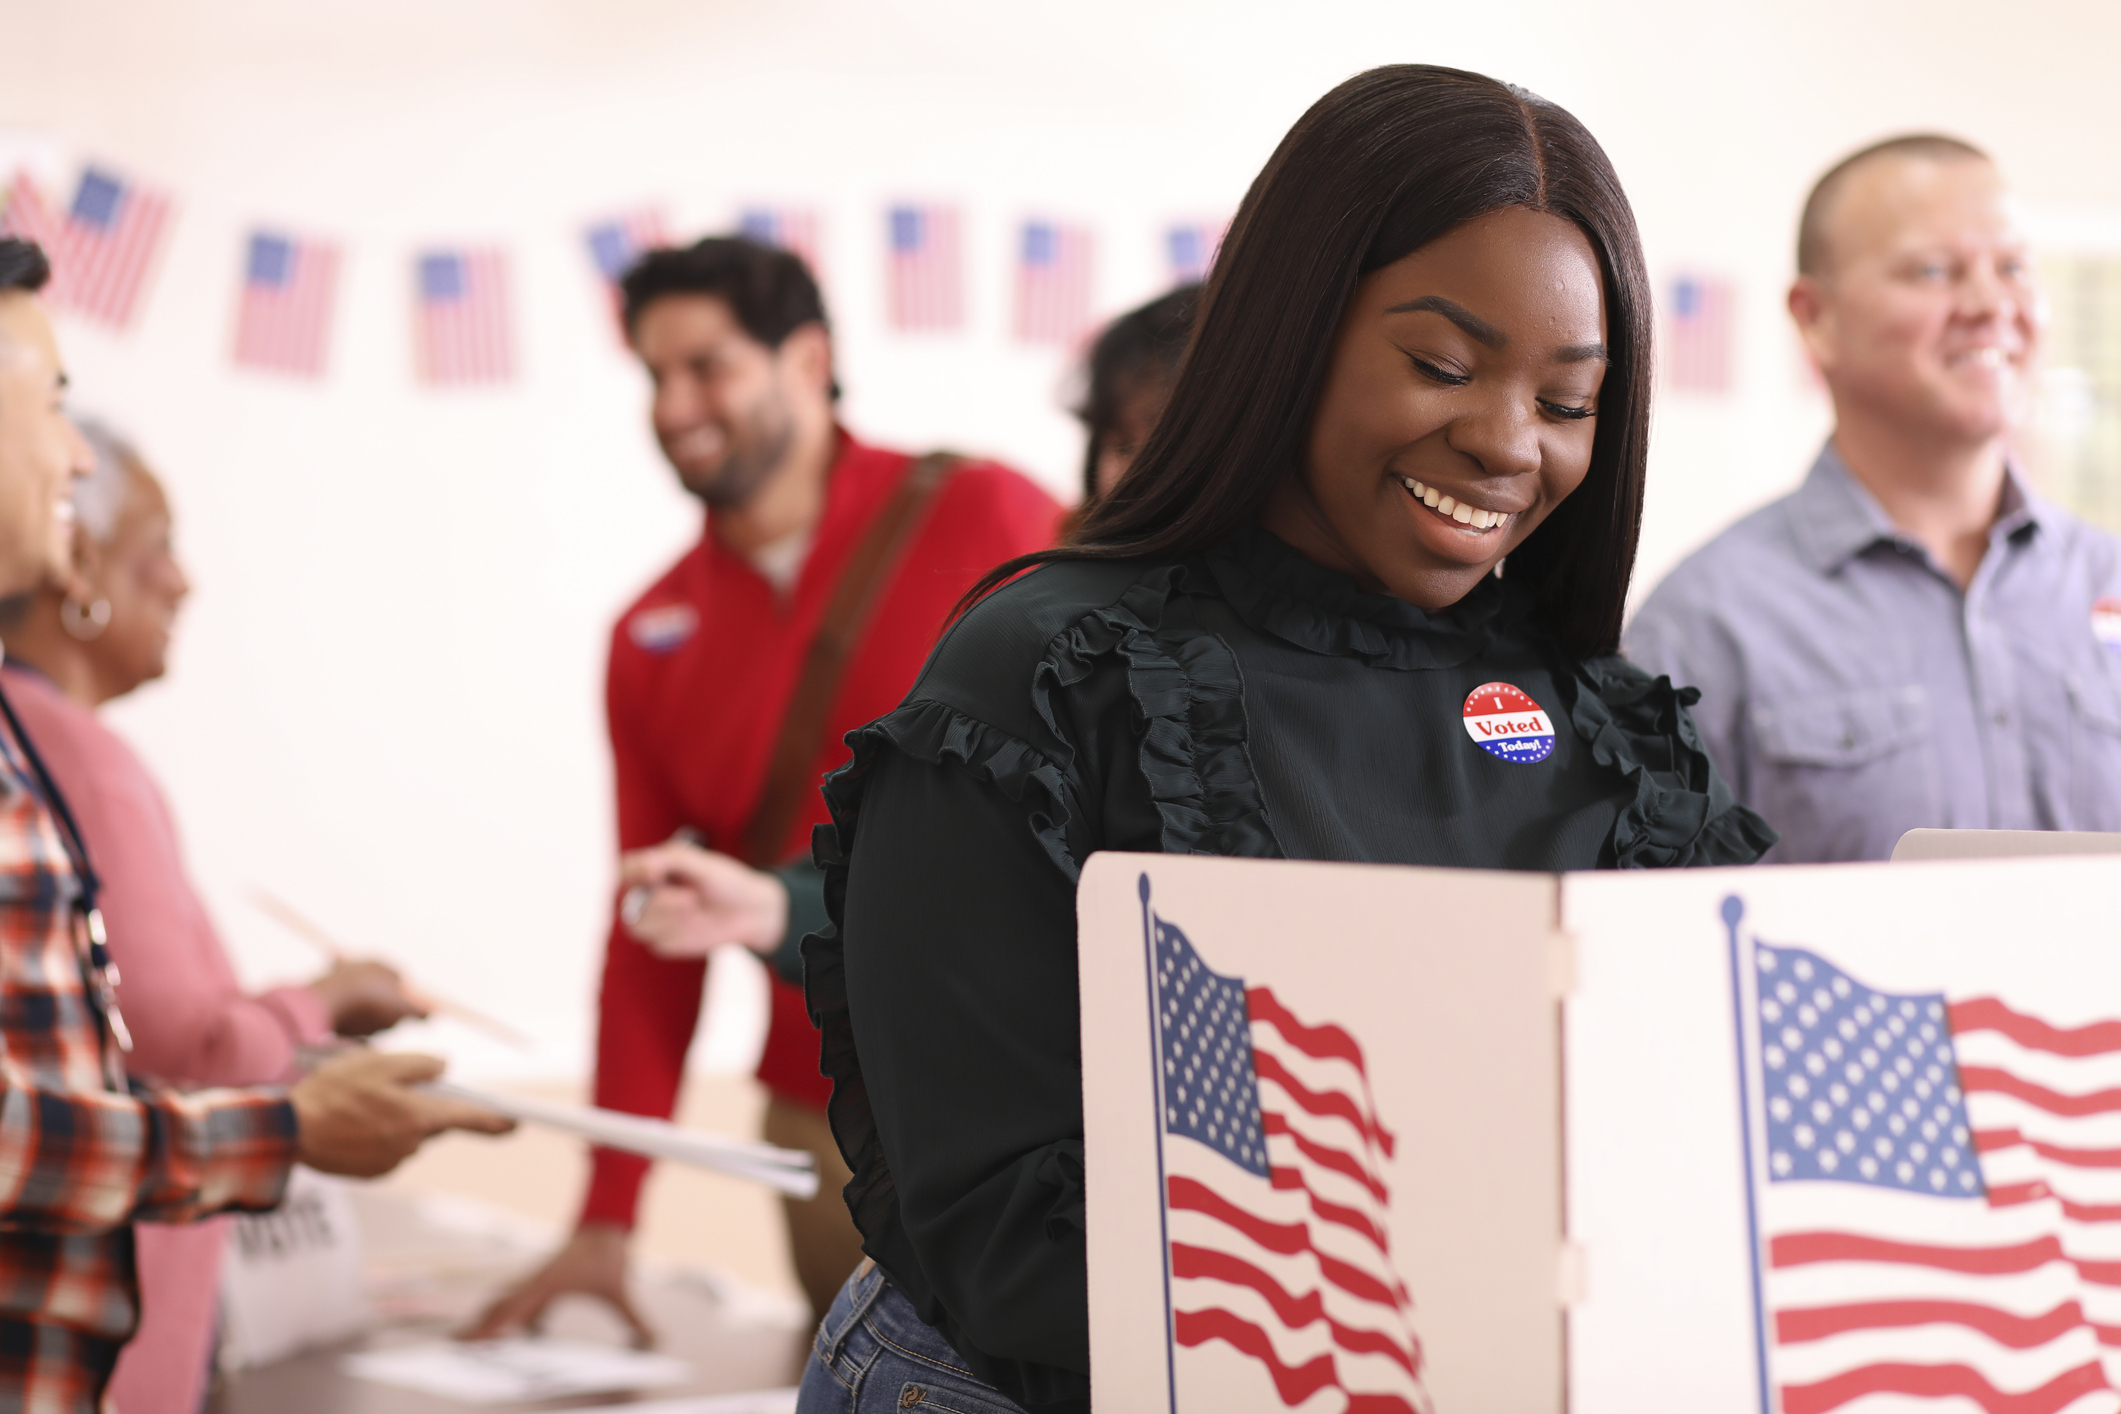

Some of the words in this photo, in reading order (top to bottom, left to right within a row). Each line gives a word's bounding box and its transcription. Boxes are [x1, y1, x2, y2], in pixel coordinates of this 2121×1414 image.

[1493, 697, 1504, 710] I
[1474, 716, 1544, 736] Voted
[1497, 739, 1542, 752] Today!
